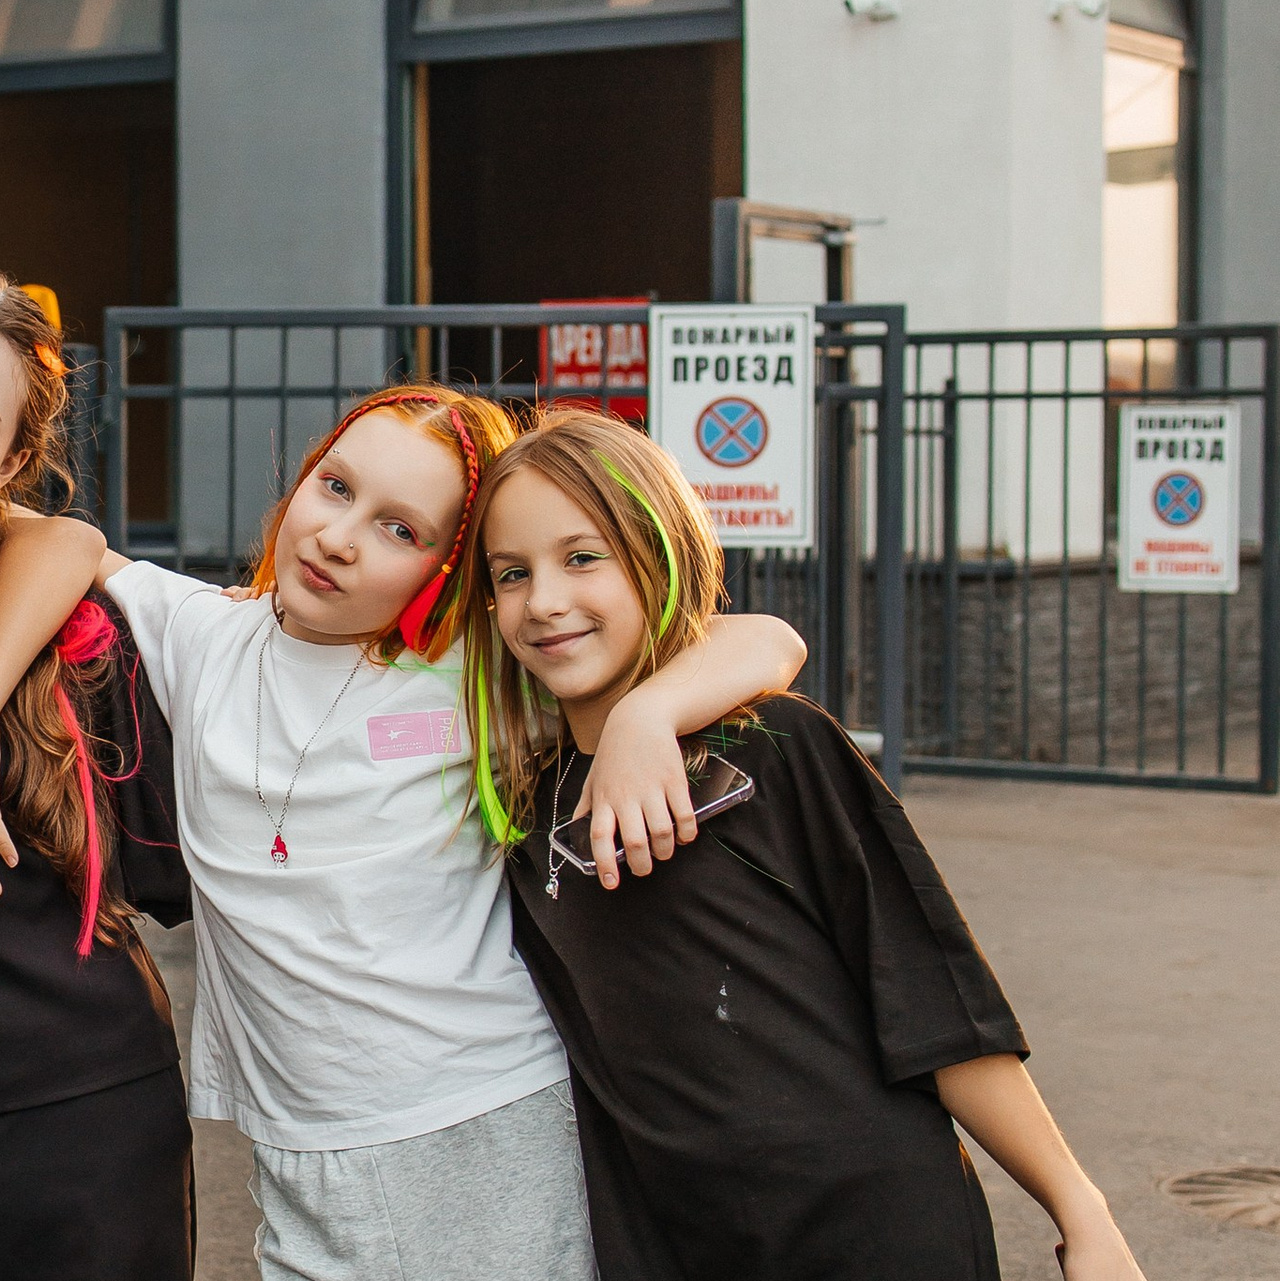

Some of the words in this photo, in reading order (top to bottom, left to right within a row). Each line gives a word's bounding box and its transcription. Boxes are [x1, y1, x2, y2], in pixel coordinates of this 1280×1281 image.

[672, 324, 795, 345] ПОЖАРНЫЙ
[672, 356, 795, 385] ПРОЕЗД
[1136, 438, 1224, 461] ПРОЕЗД
